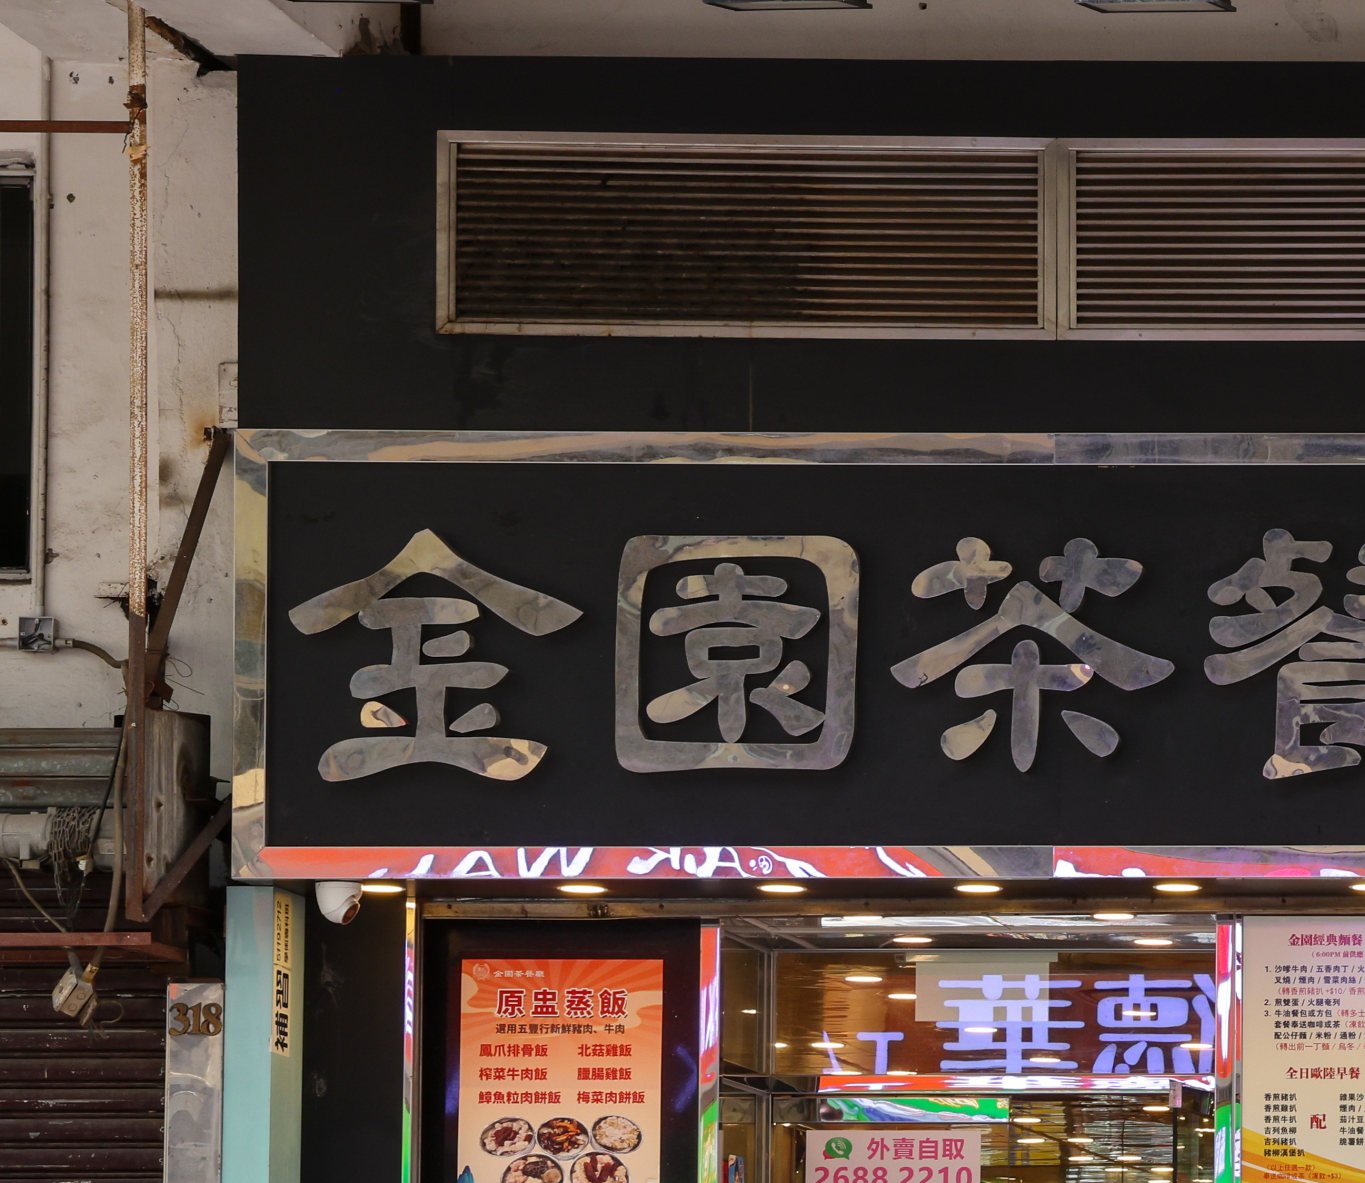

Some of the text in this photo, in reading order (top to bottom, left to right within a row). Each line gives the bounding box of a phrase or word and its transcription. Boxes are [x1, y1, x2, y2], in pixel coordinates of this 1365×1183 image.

[1288, 933, 1363, 947] 金園經典麵餐
[496, 988, 628, 1018] 原盅蒸飯
[275, 970, 289, 1053] 補習
[168, 1002, 223, 1037] 318
[496, 1024, 625, 1034] 選用五豐行新鮮豬肉、牛肉
[479, 1044, 632, 1057] 鳳爪排骨飯 北菇雞飯
[479, 1068, 547, 1081] 榨菜牛肉飯
[1286, 1067, 1361, 1080] 全日歐陸早餐
[577, 1091, 645, 1104] 梅菜肉餅飯
[1264, 1093, 1297, 1102] 香煎豬扒
[1264, 1104, 1297, 1113] 香煎雞扒
[1264, 1115, 1364, 1124] 香煎牛扒 茄汁豆
[1310, 1113, 1327, 1130] 配
[1264, 1126, 1297, 1135] 吉列魚柳
[1264, 1137, 1297, 1146] 吉列豬扒
[867, 1137, 965, 1160] 外賣自取
